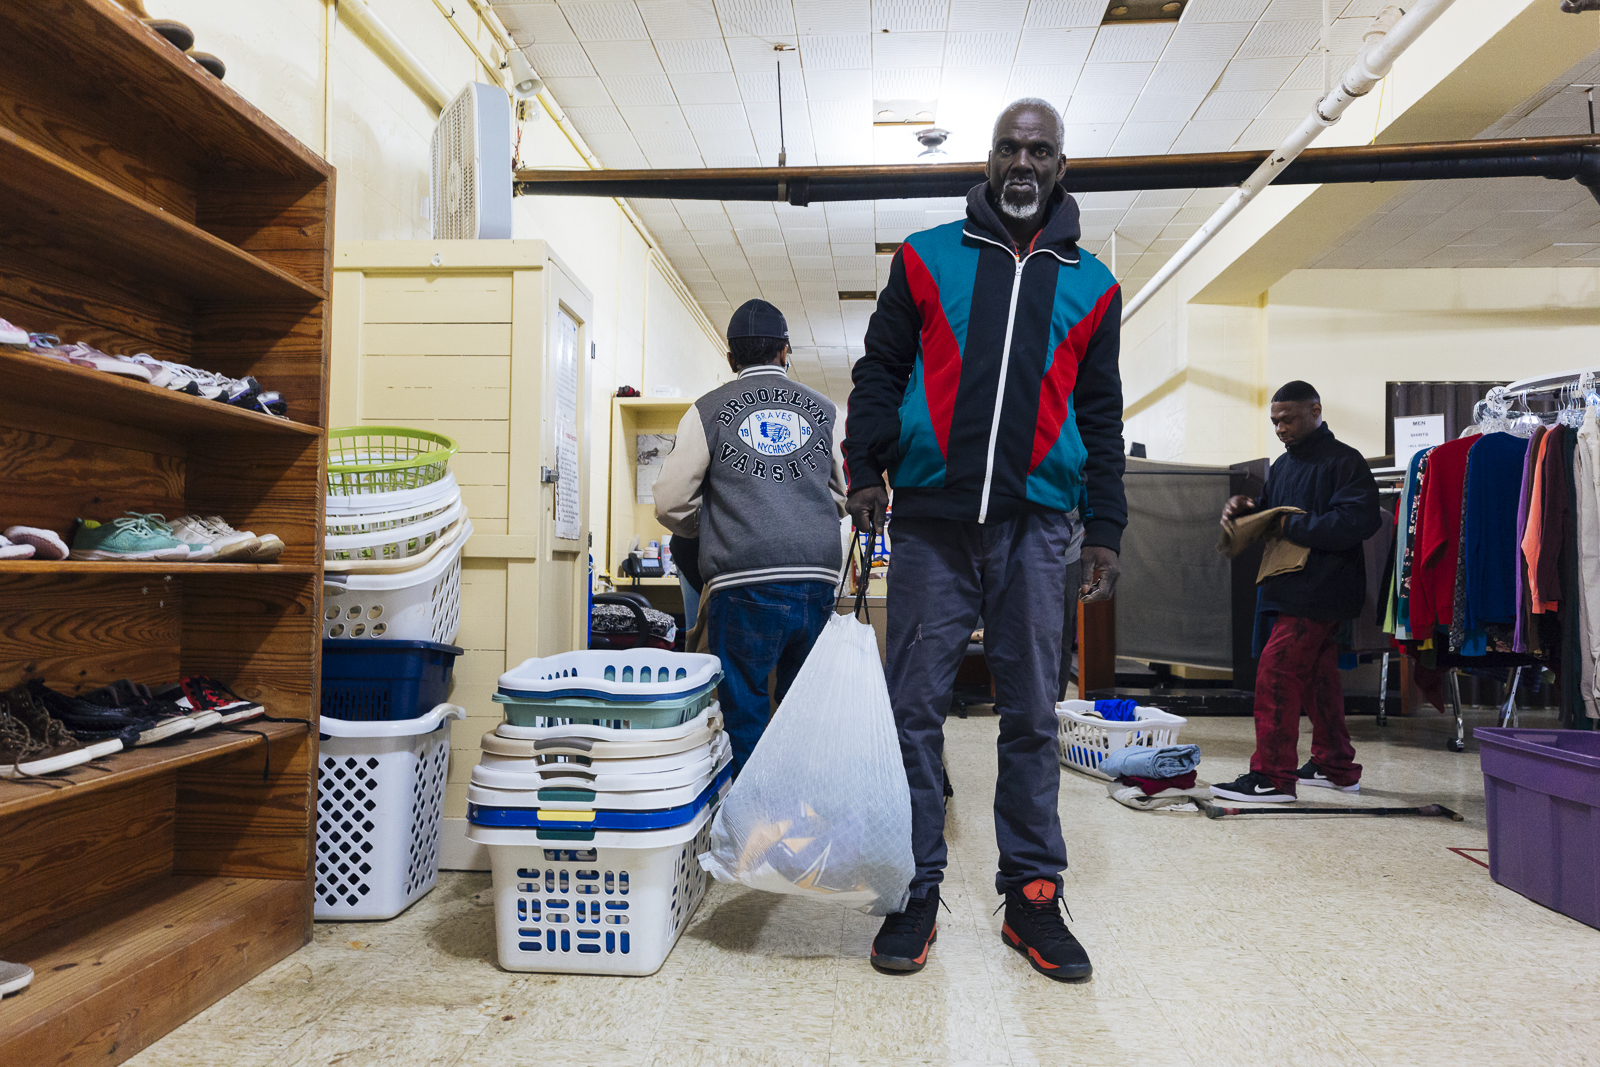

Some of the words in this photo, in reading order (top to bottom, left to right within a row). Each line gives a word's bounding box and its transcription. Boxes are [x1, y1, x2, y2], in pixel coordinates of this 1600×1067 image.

[717, 388, 829, 426] BROOKLYN
[755, 411, 793, 422] BRAVES
[740, 428, 750, 437] 19
[801, 426, 811, 436] 56
[720, 439, 830, 482] VARSITY
